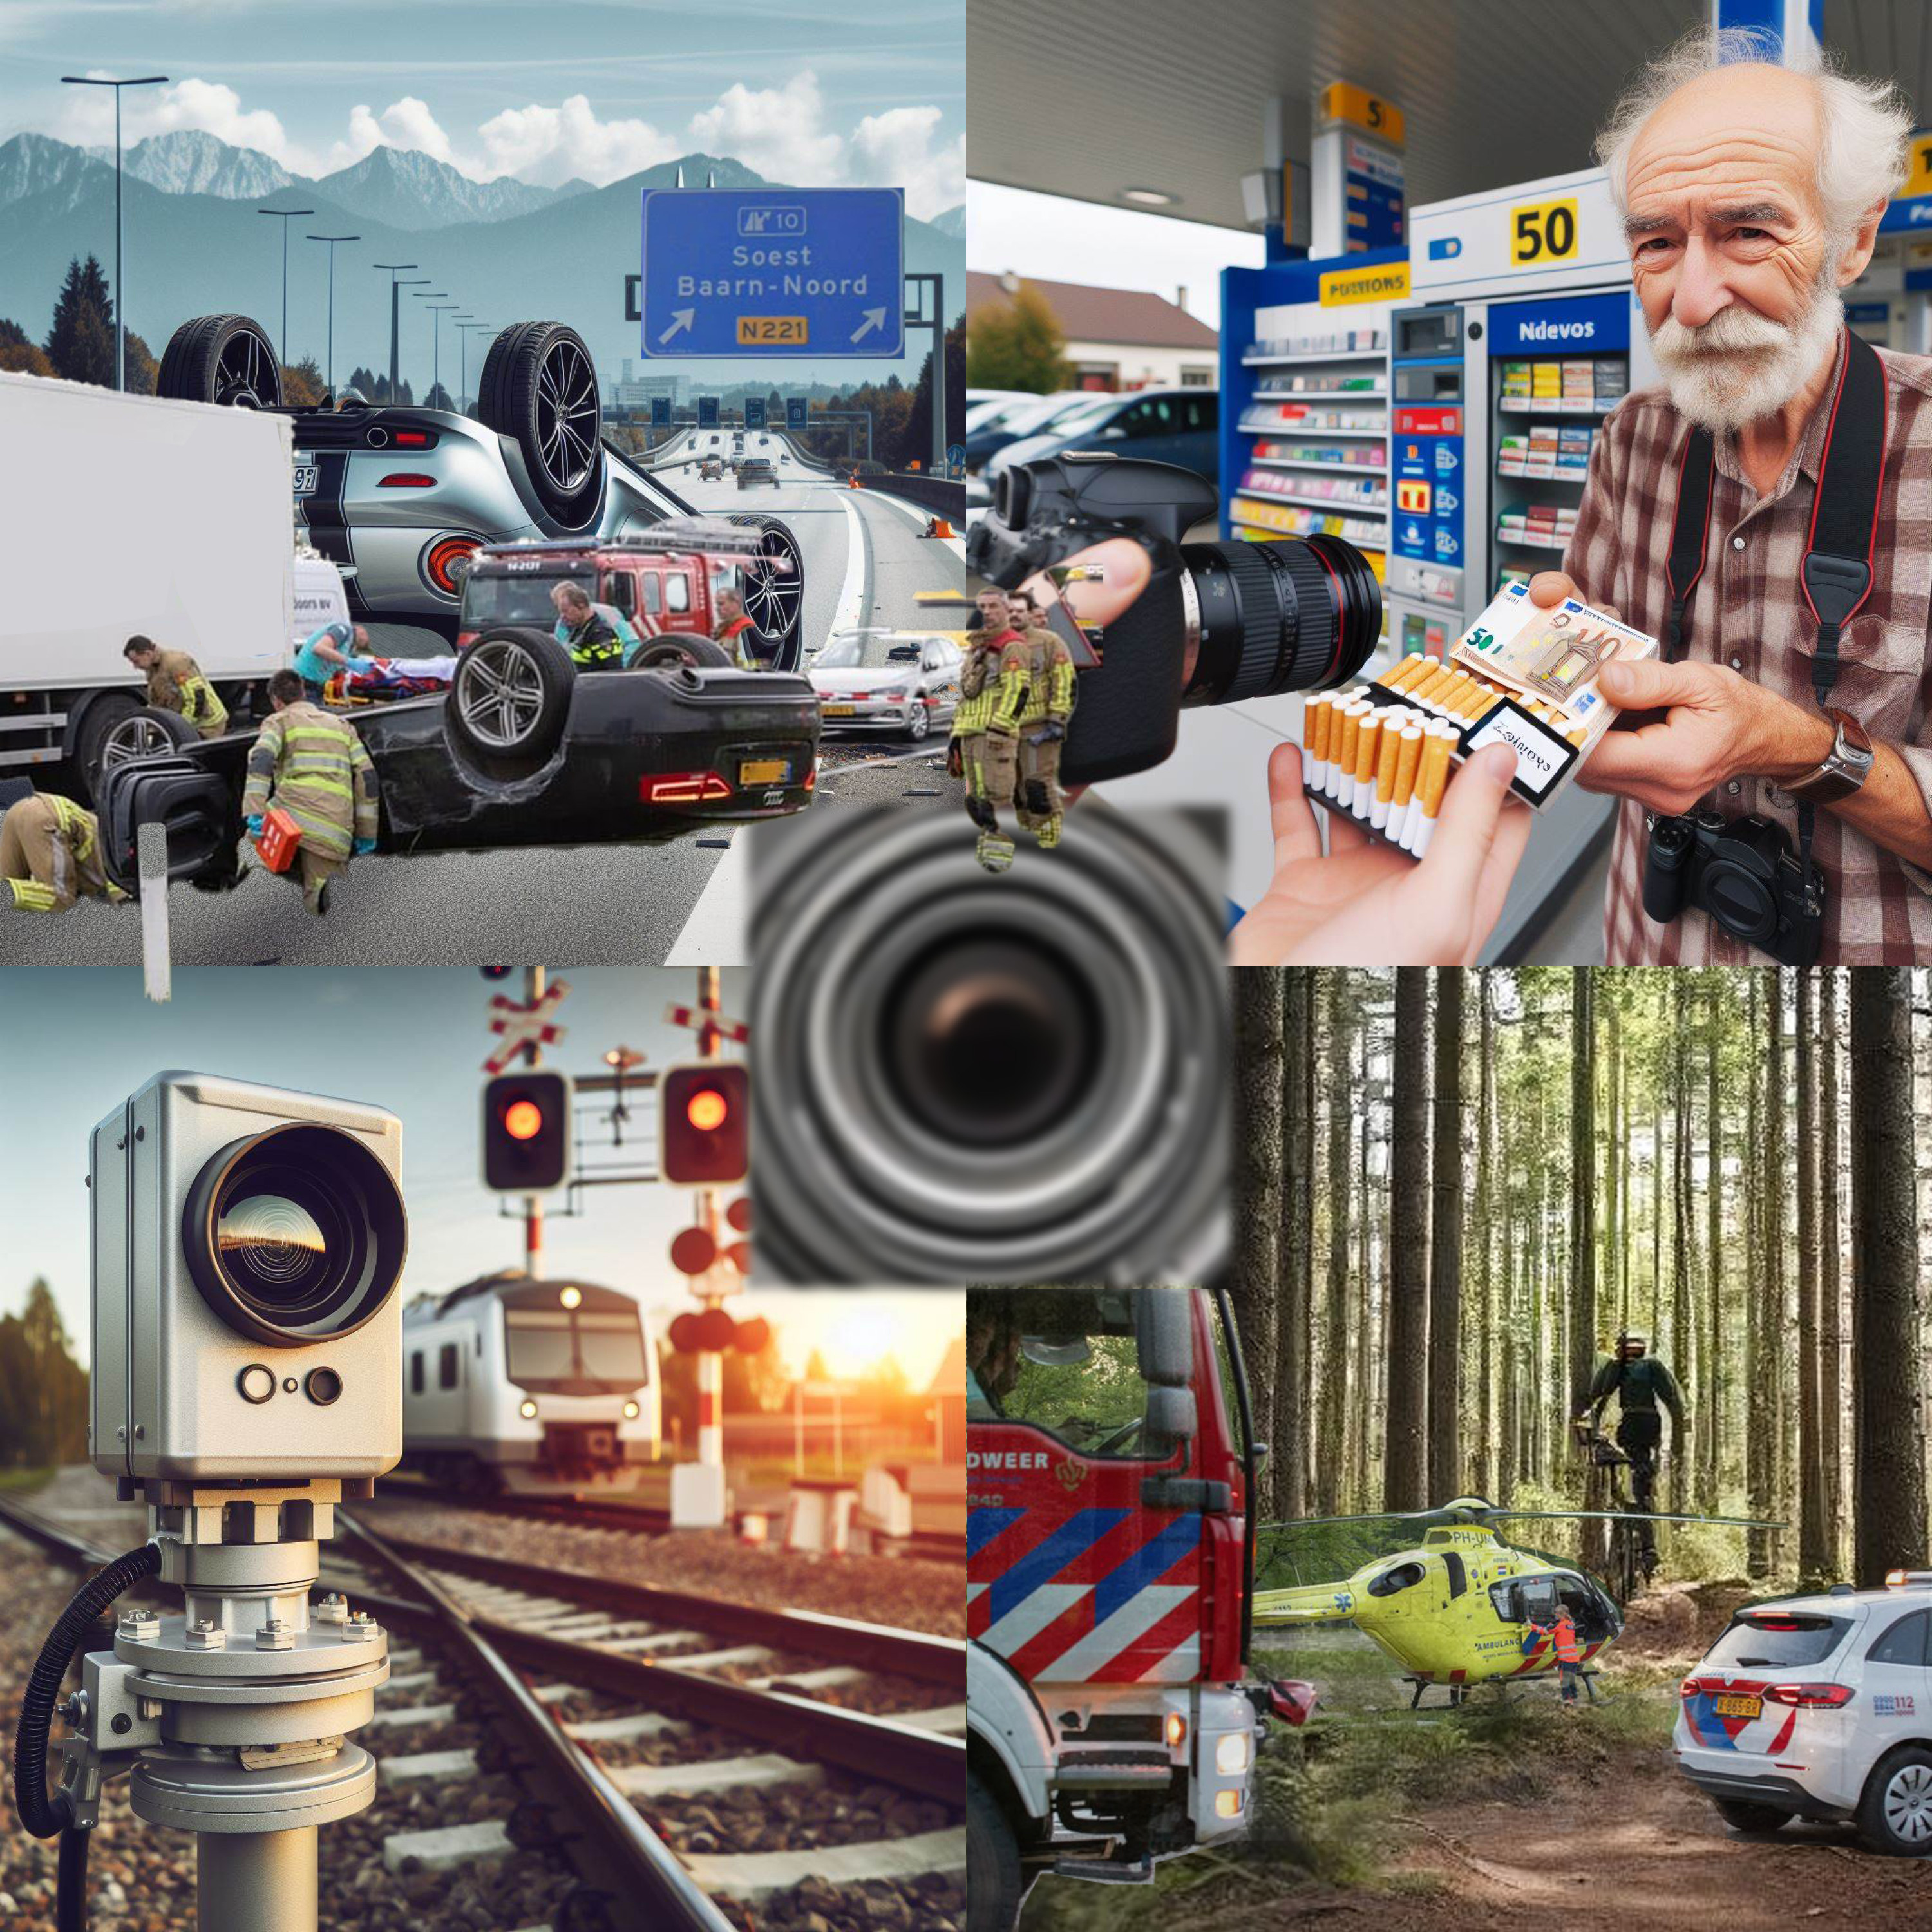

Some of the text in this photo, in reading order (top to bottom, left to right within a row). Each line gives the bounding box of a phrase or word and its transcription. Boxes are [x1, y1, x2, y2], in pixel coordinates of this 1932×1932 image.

[776, 213, 798, 229] 10
[1517, 207, 1574, 261] 50
[732, 246, 811, 266] Soest
[677, 274, 867, 296] Baarn-Noord
[742, 321, 803, 339] N221
[1519, 321, 1595, 342] Ndevos
[1466, 627, 1494, 651] 50
[966, 1452, 1048, 1468] DWEER
[1895, 1696, 1915, 1708] 112
